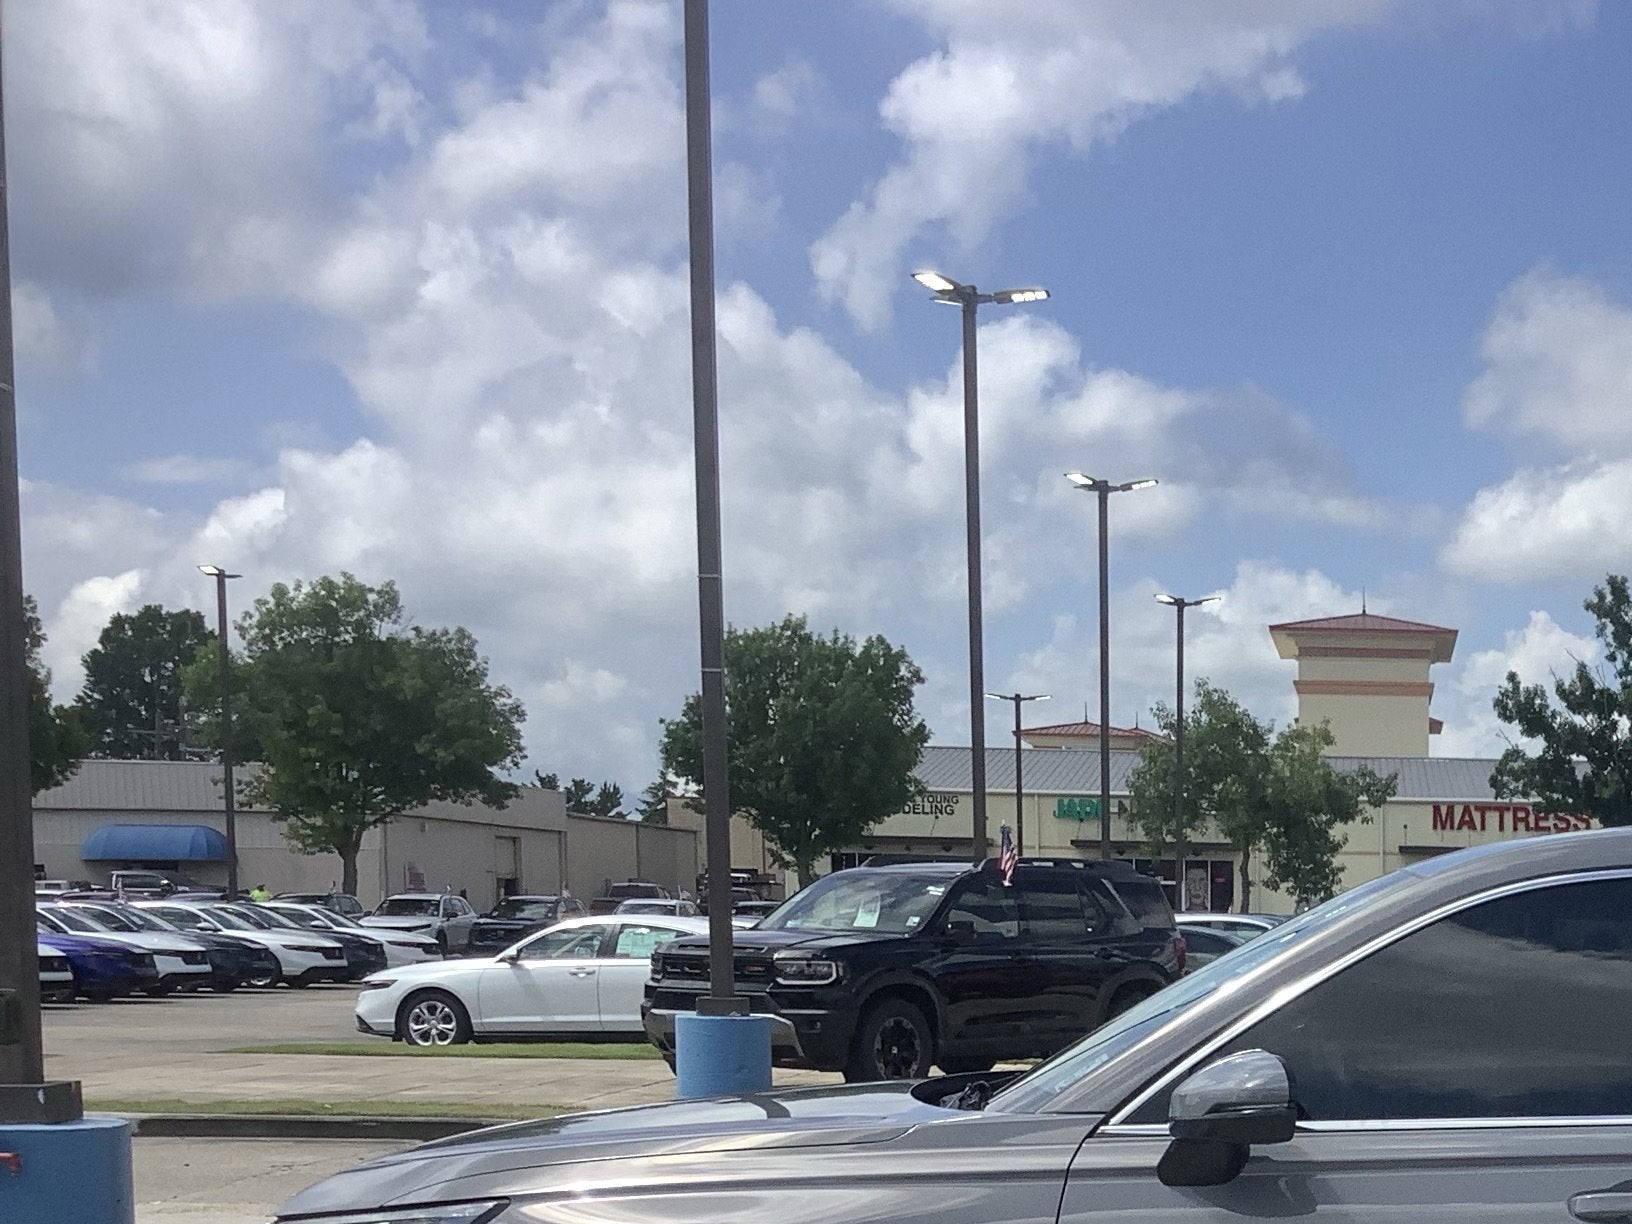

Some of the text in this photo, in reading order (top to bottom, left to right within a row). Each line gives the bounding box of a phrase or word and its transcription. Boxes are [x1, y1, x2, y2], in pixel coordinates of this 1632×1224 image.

[921, 795, 959, 804] YOUNG
[903, 804, 955, 815] DELING
[1432, 804, 1591, 832] MATTRESS
